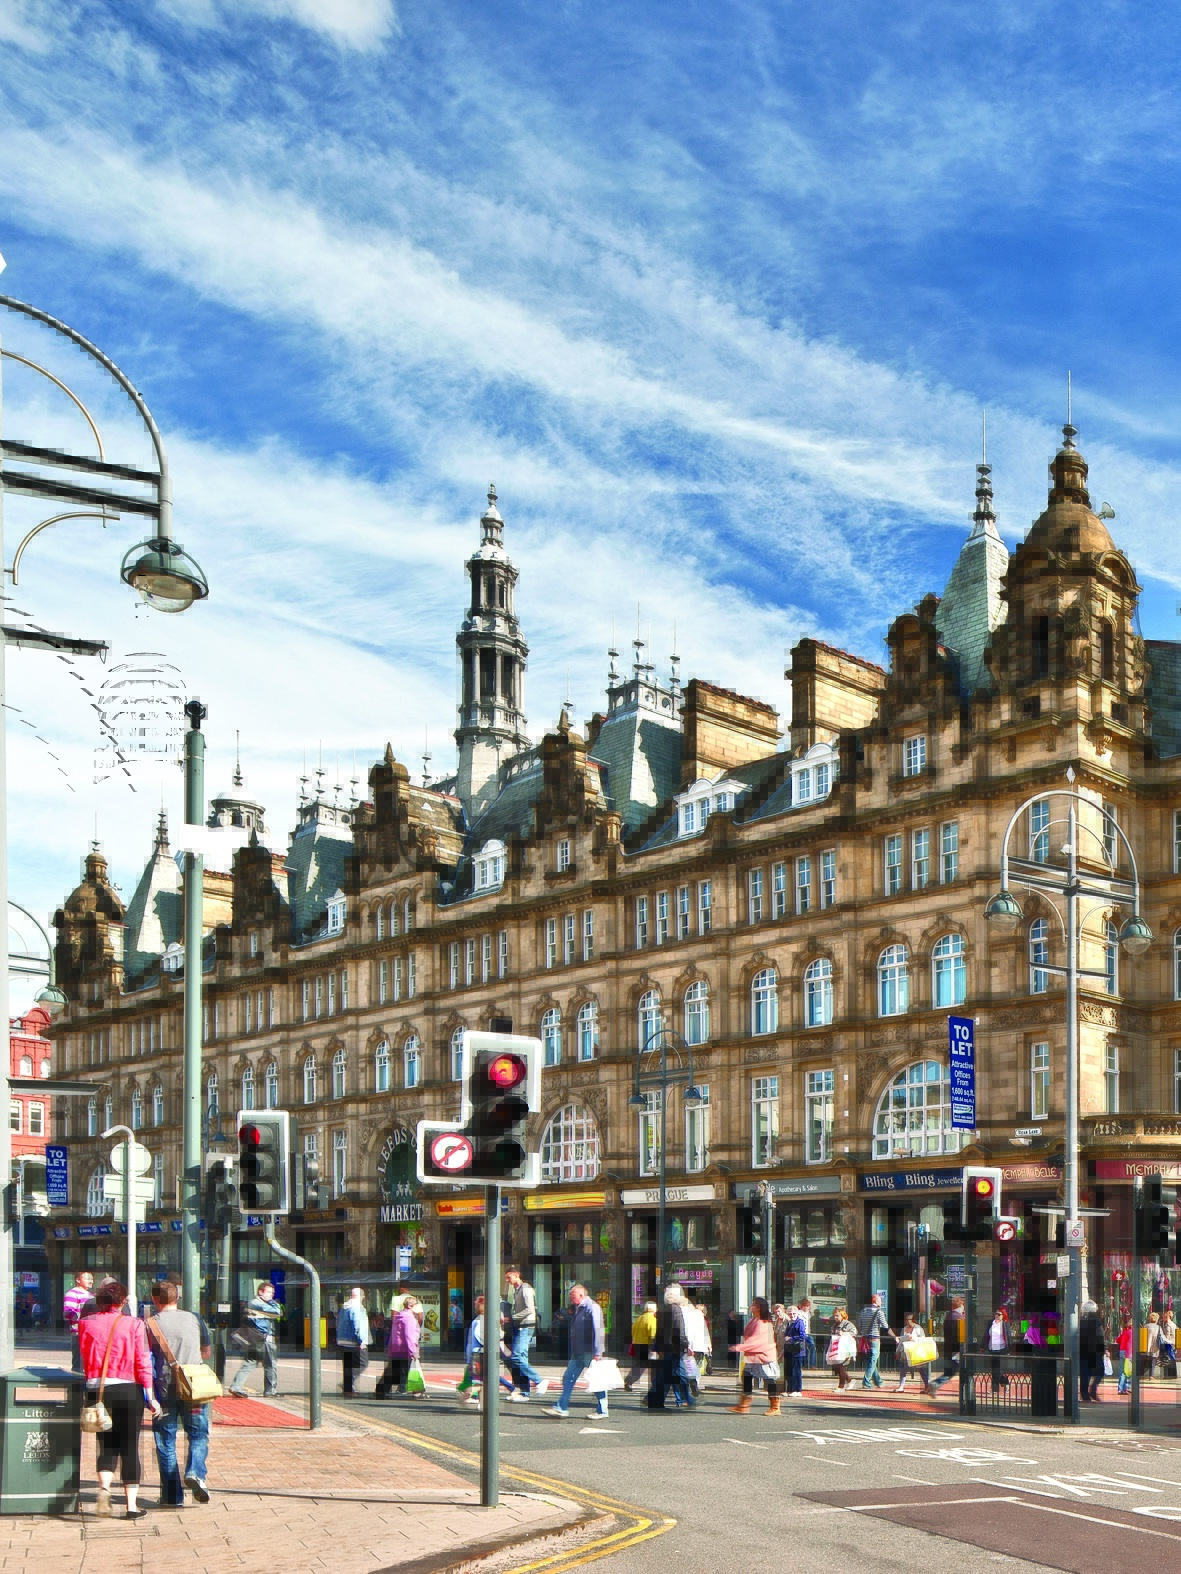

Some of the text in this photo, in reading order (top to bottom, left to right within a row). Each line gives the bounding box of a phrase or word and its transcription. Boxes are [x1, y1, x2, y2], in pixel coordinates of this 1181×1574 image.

[953, 1024, 970, 1041] TO
[951, 1040, 973, 1056] LET
[951, 1060, 974, 1070] Attractive
[954, 1069, 971, 1079] Offices
[956, 1078, 969, 1086] From
[49, 1149, 64, 1159] TO
[377, 1126, 408, 1174] LEEDS
[47, 1158, 66, 1167] LET
[1033, 1166, 1058, 1178] BELLE
[865, 1175, 895, 1189] Bling
[905, 1173, 936, 1187] Bling
[644, 1189, 689, 1202] PRGUE
[678, 1268, 713, 1280] Prague
[24, 1409, 55, 1418] Litter
[793, 1426, 965, 1446] ONLY
